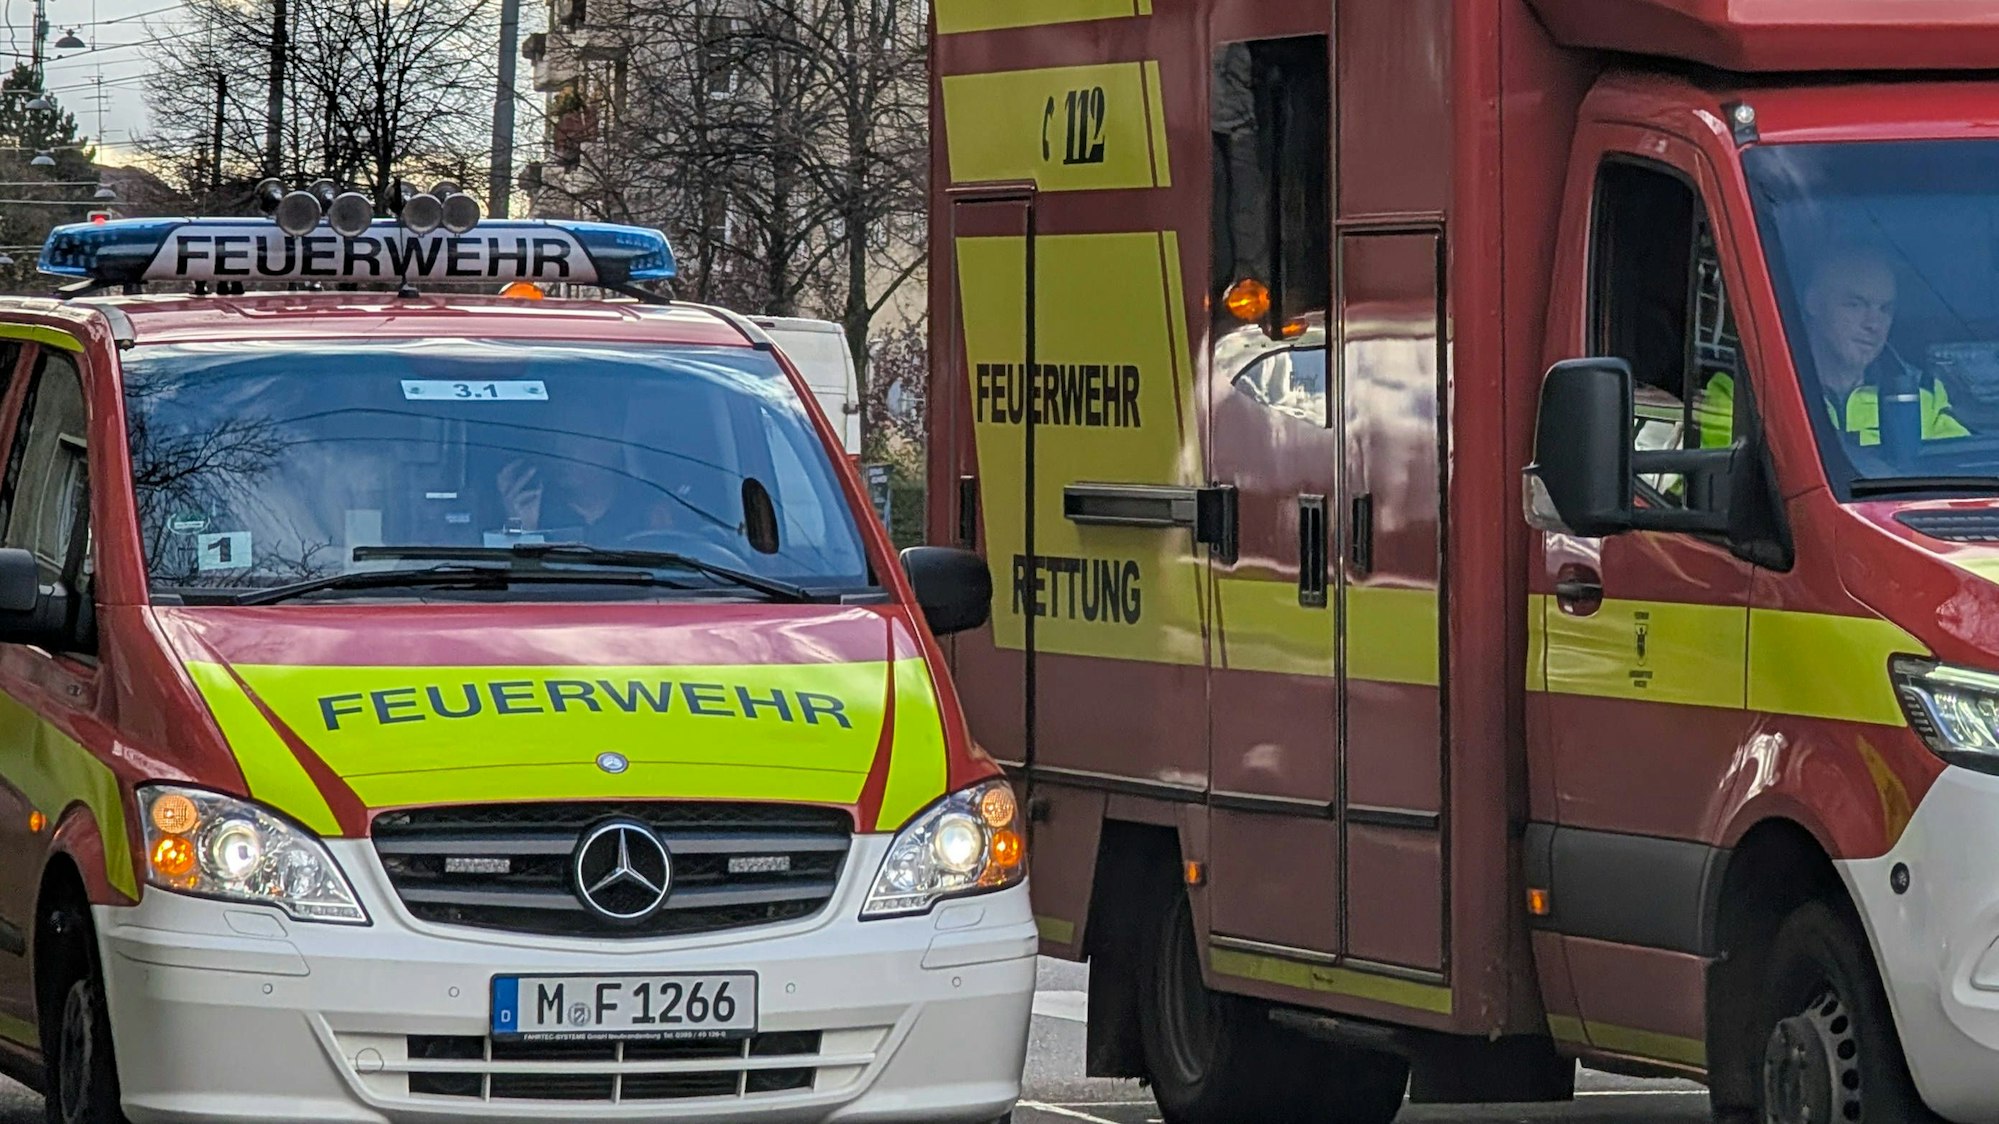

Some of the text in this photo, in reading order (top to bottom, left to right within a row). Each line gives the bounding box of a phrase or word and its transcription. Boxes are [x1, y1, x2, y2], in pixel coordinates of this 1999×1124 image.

[1063, 86, 1105, 165] 112
[176, 235, 572, 280] FEUERWEHR
[453, 383, 498, 398] 3.1
[976, 363, 1141, 428] FEUERWEHR
[207, 537, 231, 563] 1
[1012, 554, 1141, 625] RETTUNG
[317, 679, 854, 731] FEUERWEHR
[501, 1009, 511, 1023] D
[537, 981, 736, 1025] M F 1266
